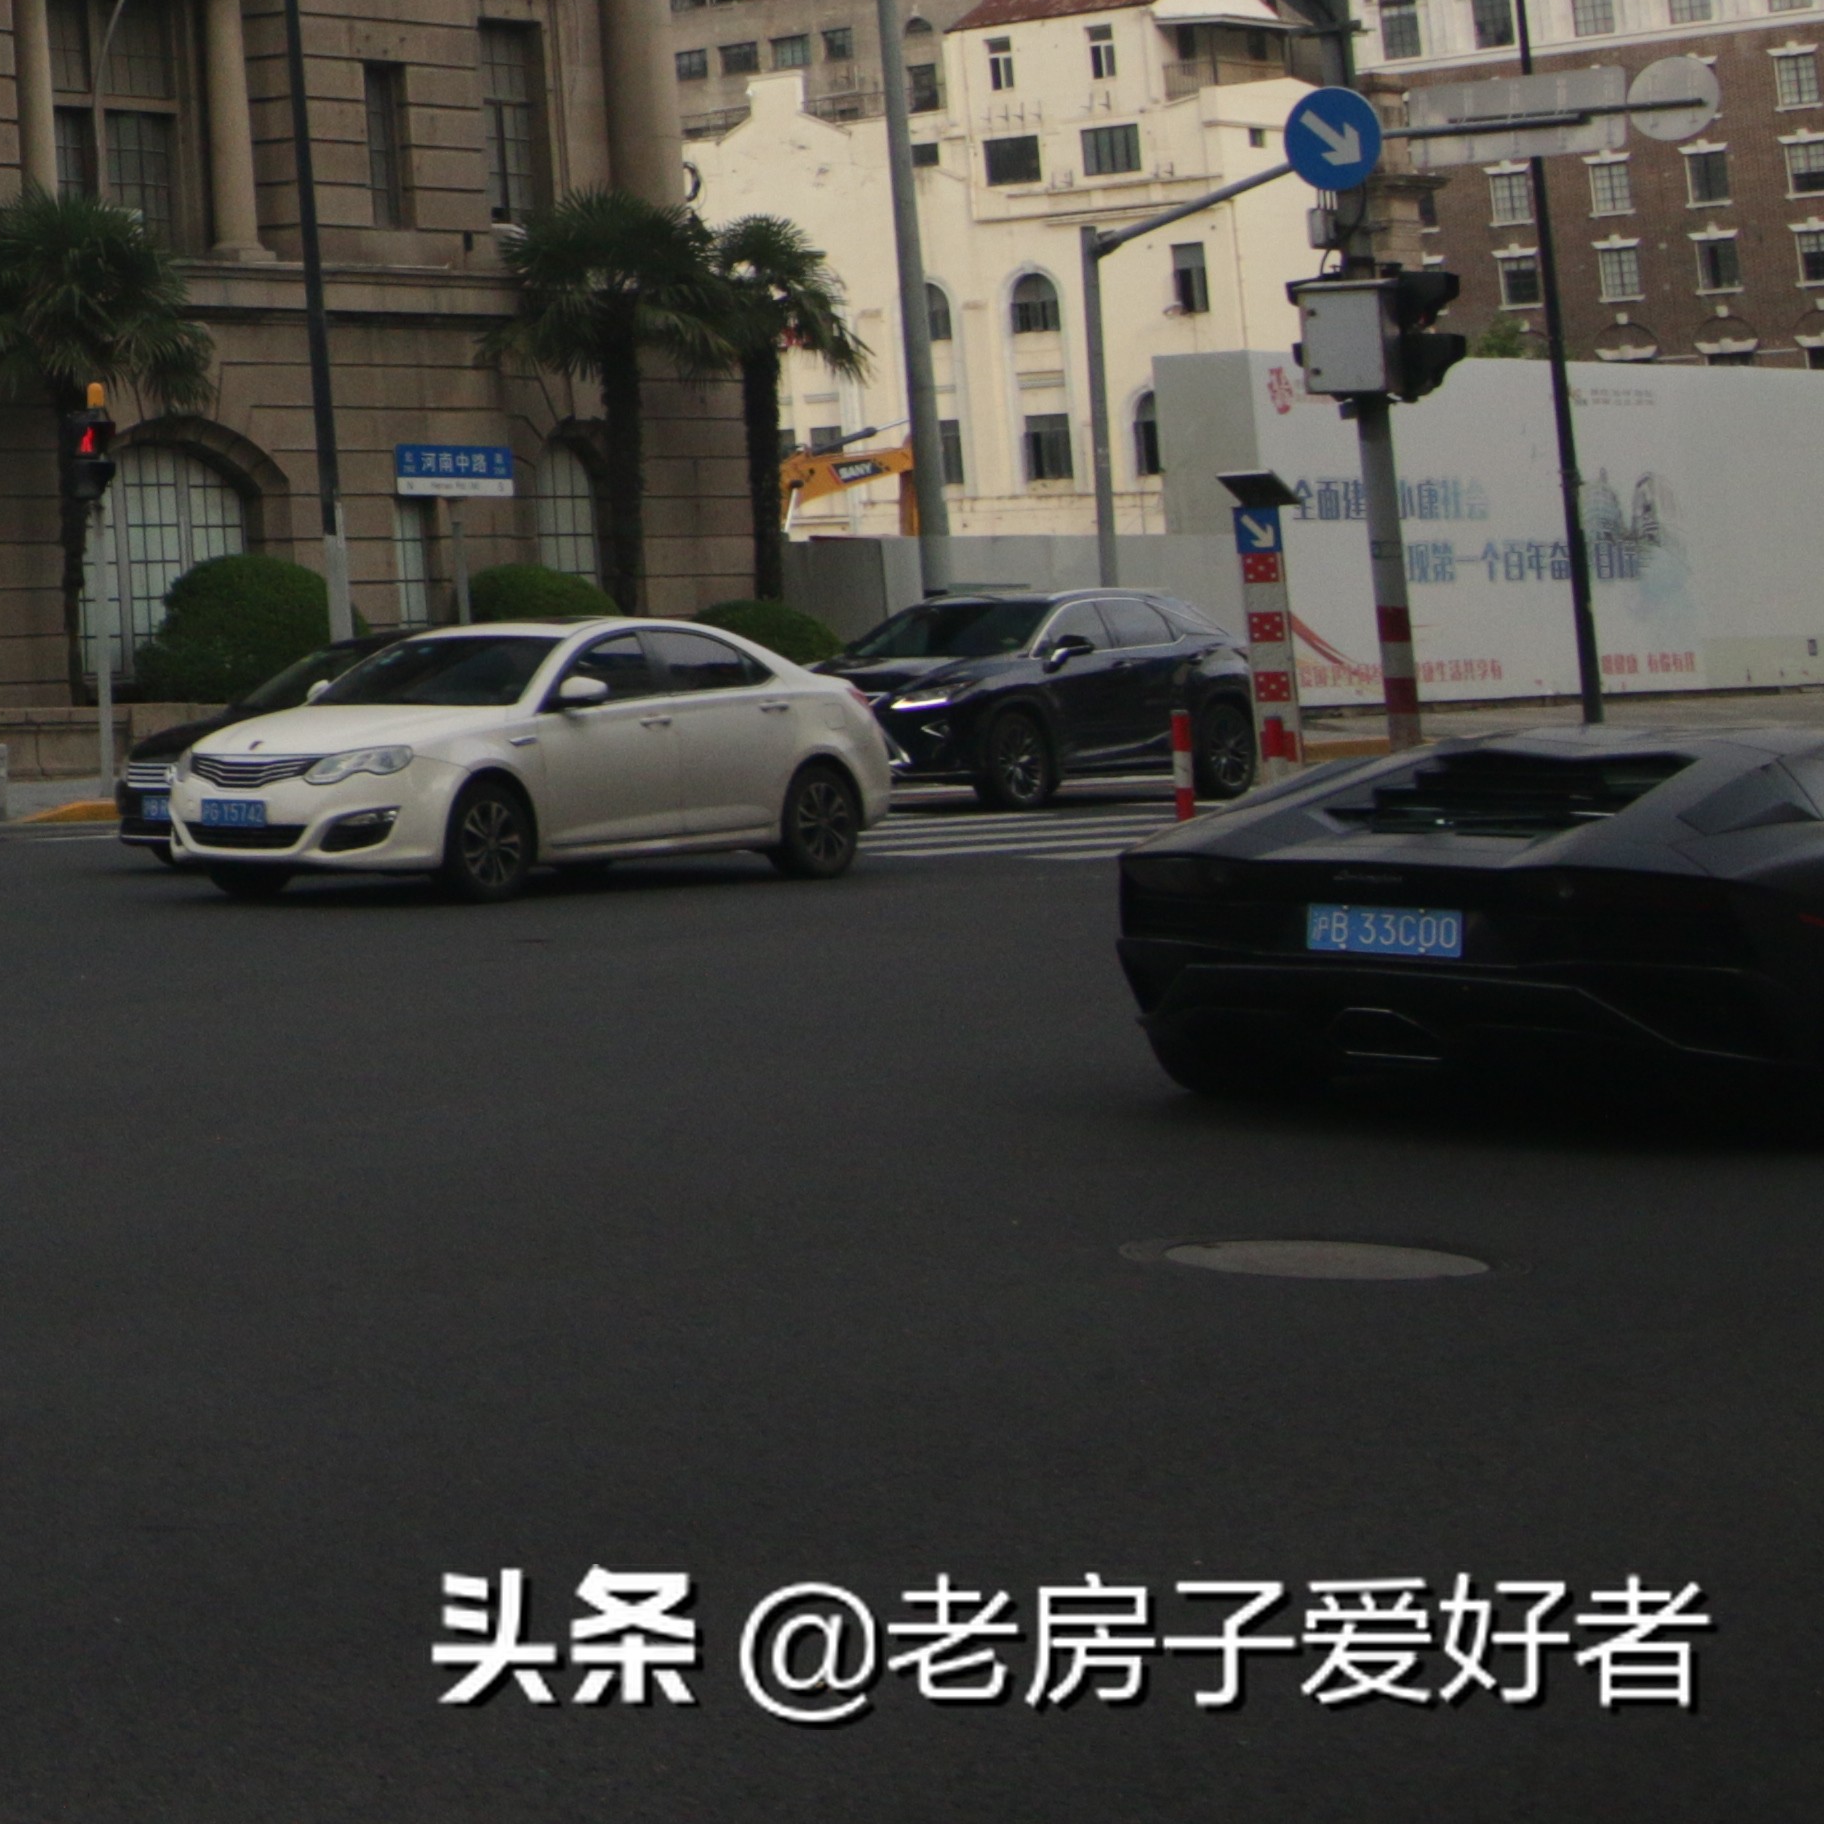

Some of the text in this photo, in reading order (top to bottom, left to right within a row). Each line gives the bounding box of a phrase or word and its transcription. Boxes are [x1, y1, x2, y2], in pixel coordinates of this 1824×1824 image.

[420, 451, 487, 473] 河南中路
[838, 462, 873, 480] SANY
[1293, 479, 1489, 521] 全面建小康社会
[1407, 541, 1638, 582] 现第一个百年奋目标
